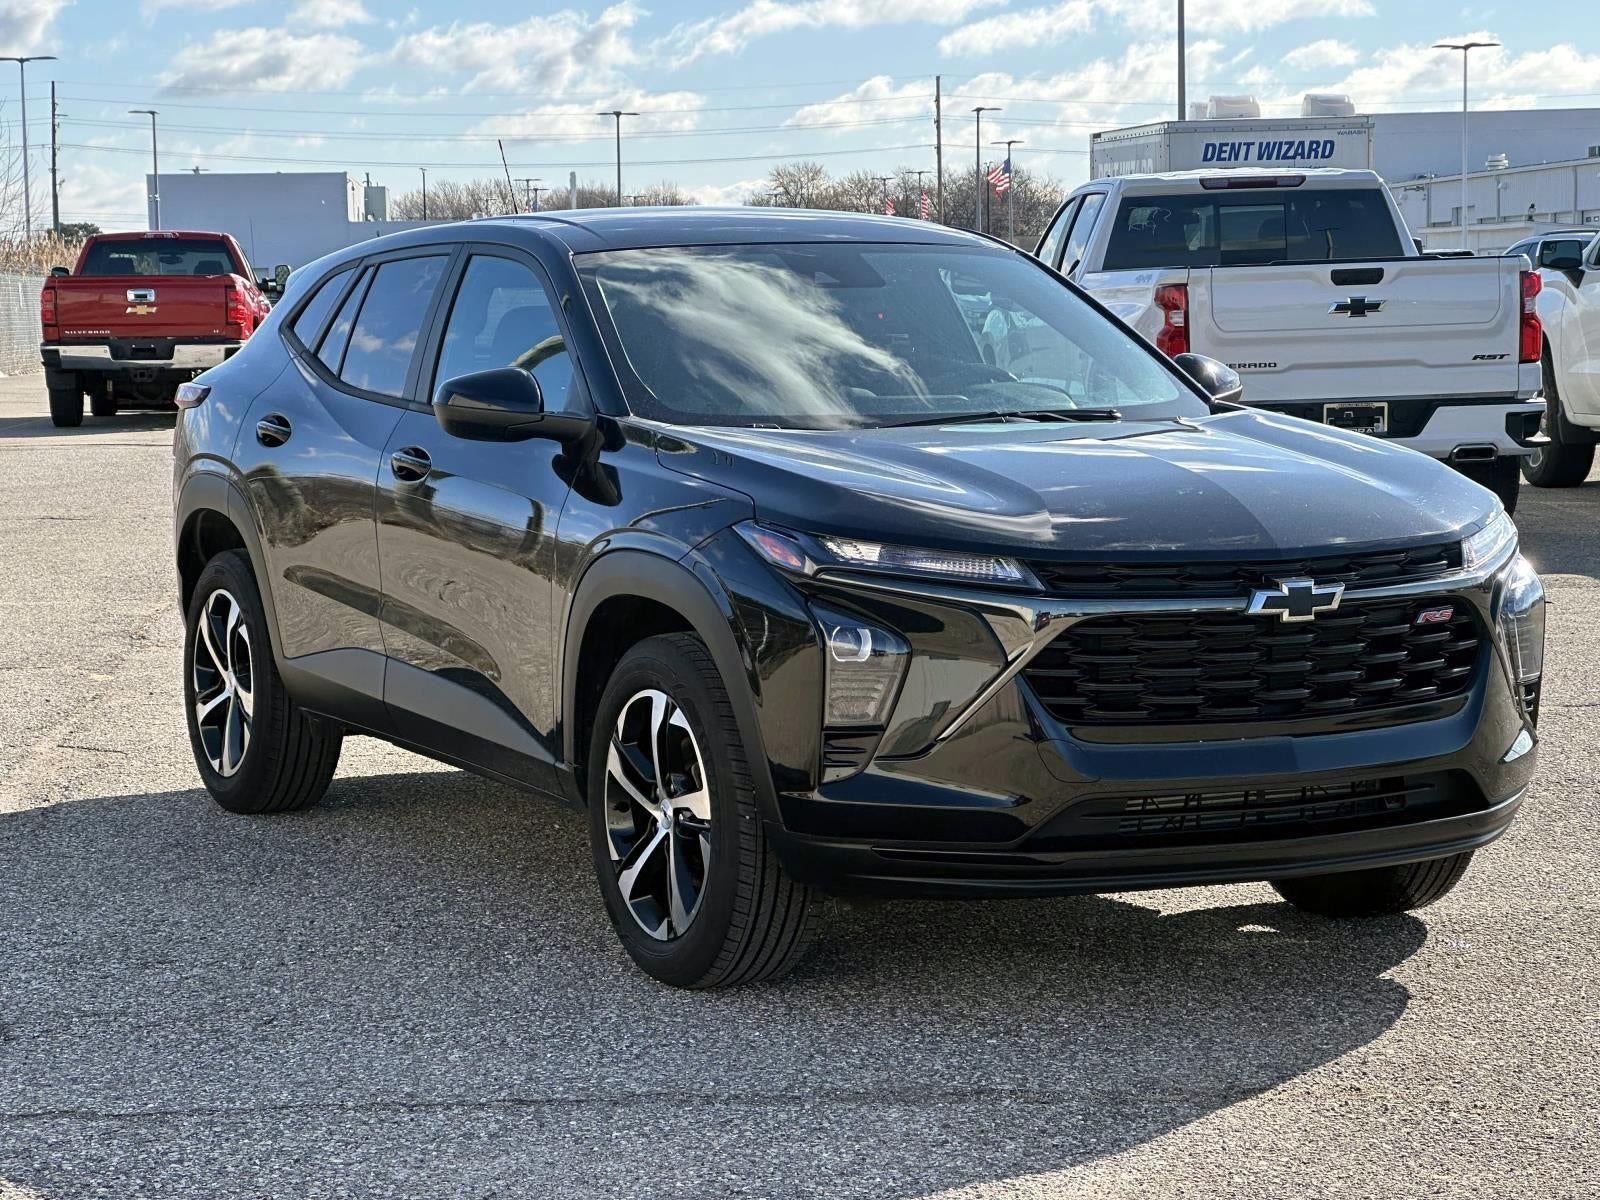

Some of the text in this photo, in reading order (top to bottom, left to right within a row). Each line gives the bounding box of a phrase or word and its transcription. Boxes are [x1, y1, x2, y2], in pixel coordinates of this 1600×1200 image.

[1202, 139, 1335, 162] DENT WIZARD
[1471, 353, 1511, 361] RST
[1416, 607, 1454, 624] RS
